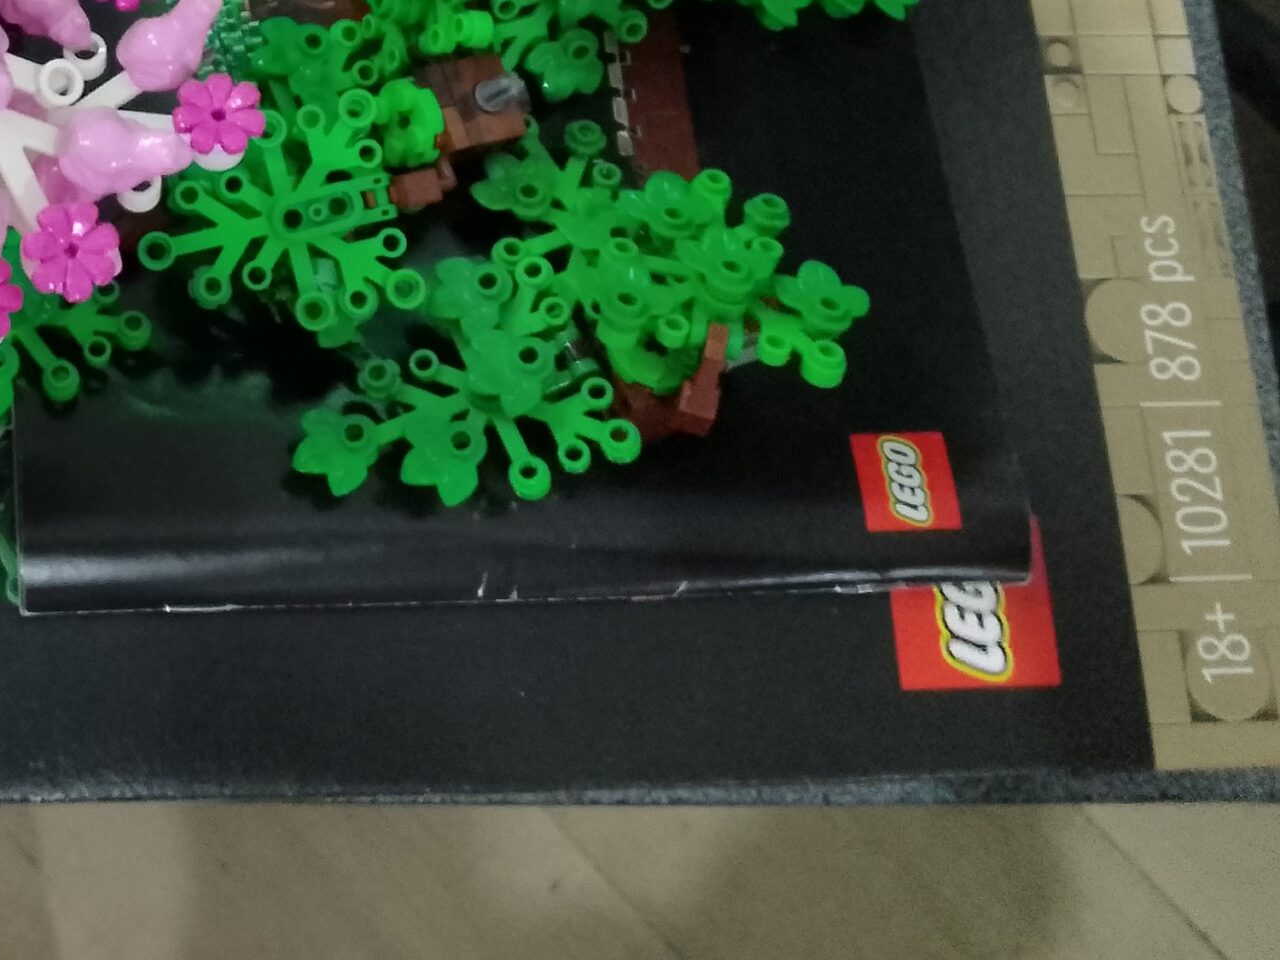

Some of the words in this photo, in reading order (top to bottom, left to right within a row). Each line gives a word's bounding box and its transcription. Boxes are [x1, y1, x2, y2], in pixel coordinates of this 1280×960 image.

[1139, 214, 1196, 282] pcs
[1140, 301, 1201, 381] 878
[880, 438, 932, 524] LEGO
[1162, 429, 1231, 557] 10281
[937, 581, 1009, 676] LEG
[1196, 602, 1254, 684] 18+
